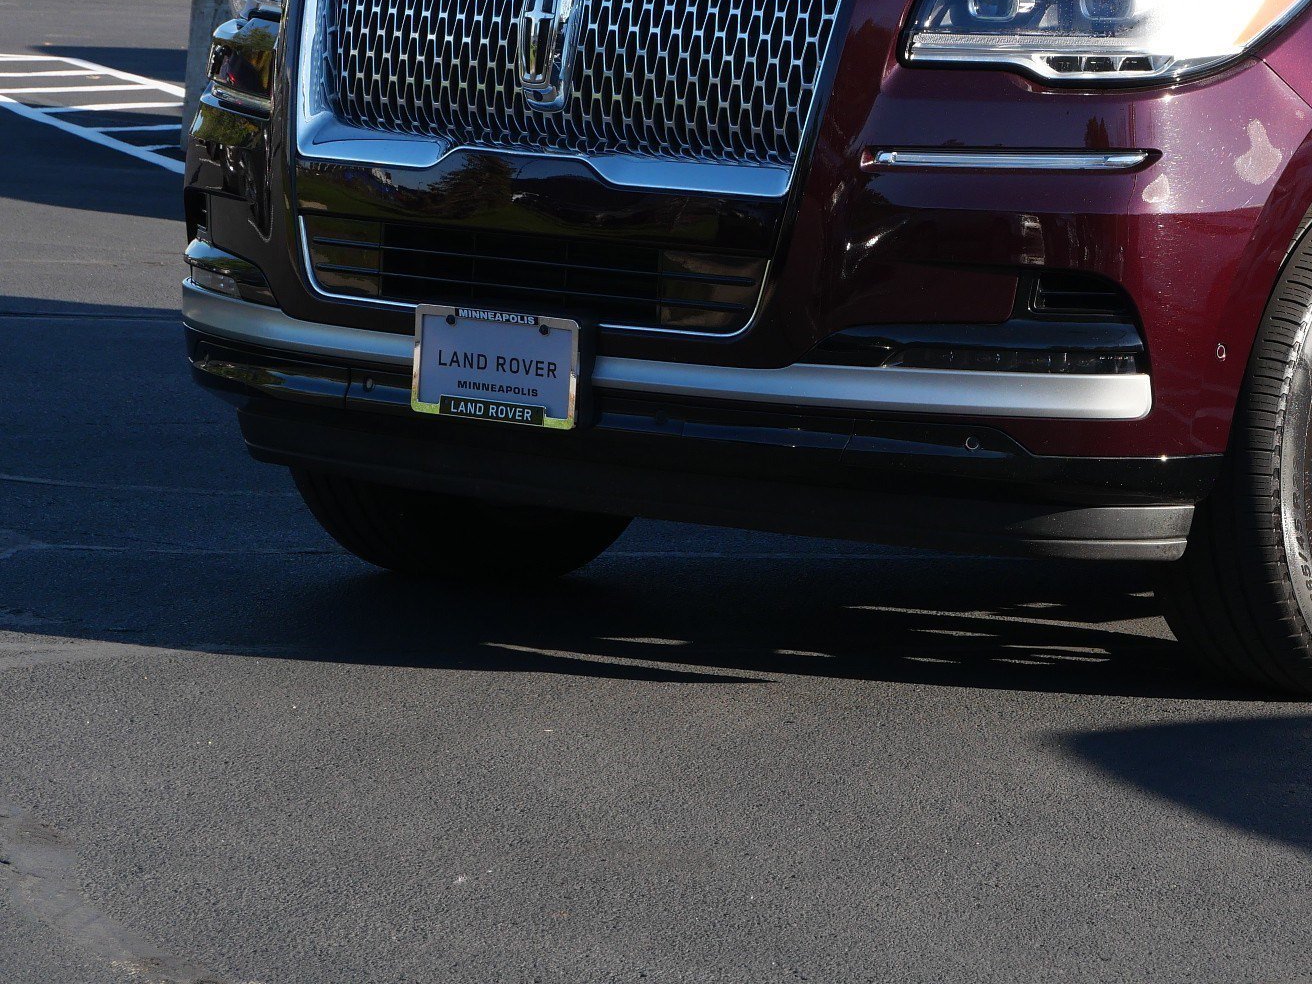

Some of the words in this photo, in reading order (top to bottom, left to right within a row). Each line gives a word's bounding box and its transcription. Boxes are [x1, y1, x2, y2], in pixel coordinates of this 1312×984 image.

[458, 308, 536, 325] MINNEAPOLIS
[438, 349, 488, 371] LAND
[496, 356, 557, 379] ROVER
[457, 380, 538, 397] MINNEAPOLIS
[450, 400, 484, 415] LAND
[488, 405, 532, 421] ROVER
